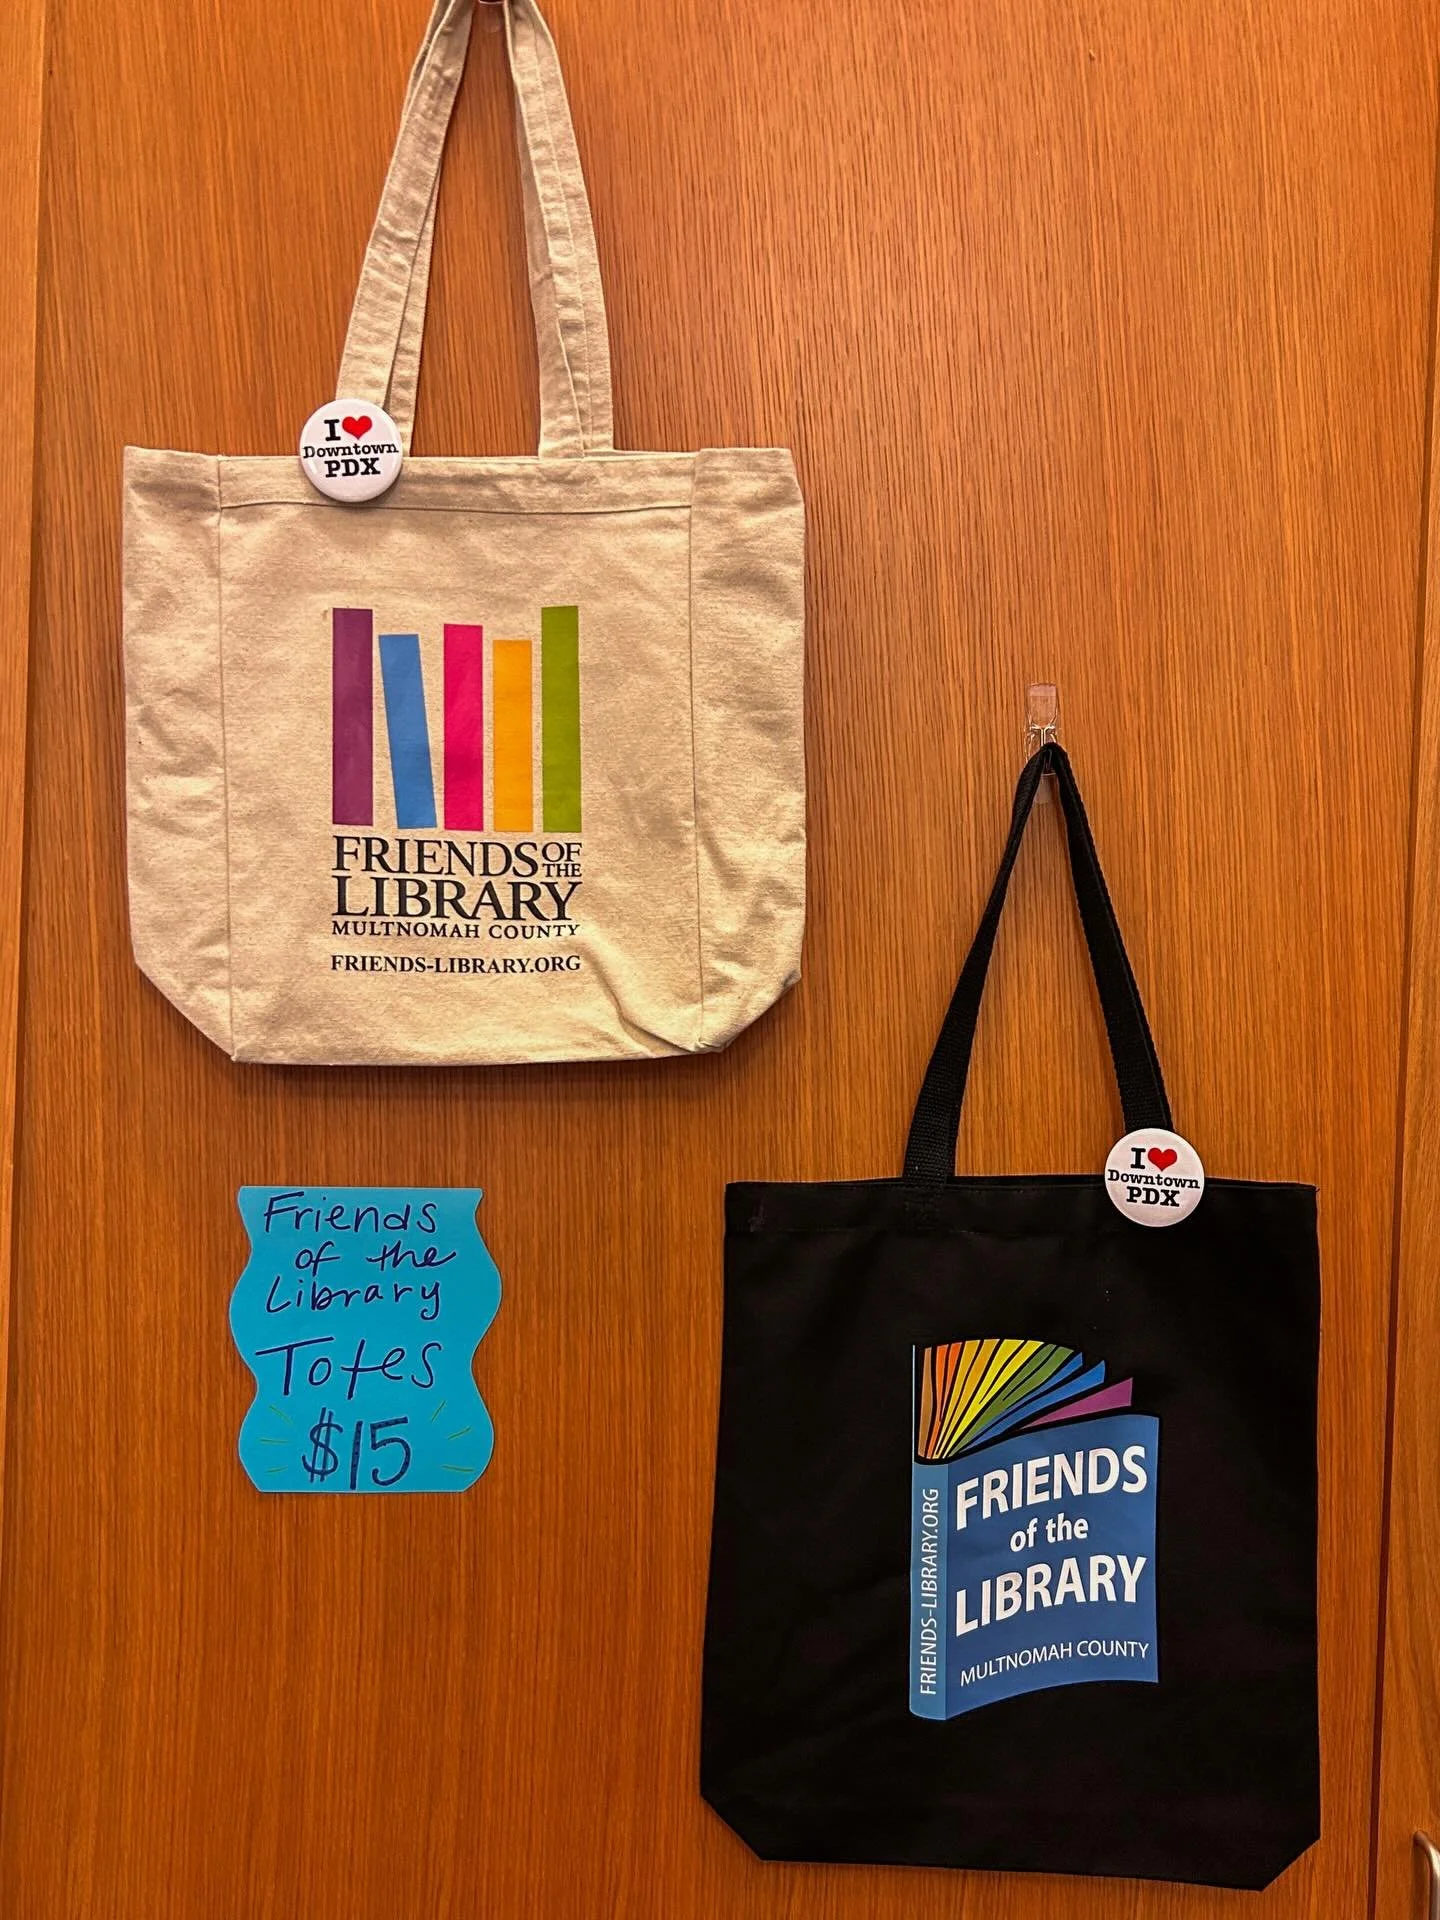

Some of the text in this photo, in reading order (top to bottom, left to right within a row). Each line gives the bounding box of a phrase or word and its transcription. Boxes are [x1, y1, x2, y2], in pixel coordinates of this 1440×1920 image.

[324, 418, 341, 441] I
[303, 443, 399, 459] Downtown
[324, 457, 381, 478] PDX
[332, 835, 583, 877] FRIENDS OF
[542, 863, 583, 878] THE
[331, 875, 583, 921] LIBRARY
[331, 920, 581, 940] MULTNOMAH COUNTY
[331, 954, 581, 974] FRIENDS-LIBRARY.ORG
[1107, 1168, 1200, 1189] Downtown
[1130, 1147, 1147, 1170] I
[264, 1190, 436, 1234] Friends
[1126, 1185, 1180, 1208] PDX
[295, 1240, 457, 1277] of the
[265, 1275, 441, 1321] Library
[255, 1336, 442, 1401] Totes
[301, 1406, 412, 1490] $15
[956, 1444, 1148, 1532] FRIENDS
[1009, 1512, 1089, 1553] of the
[919, 1487, 940, 1696] FRIENDS-LIBRARY.ORG
[956, 1553, 1148, 1638] LIBRARY
[959, 1639, 1149, 1687] MULTNOMAH COUNTY
